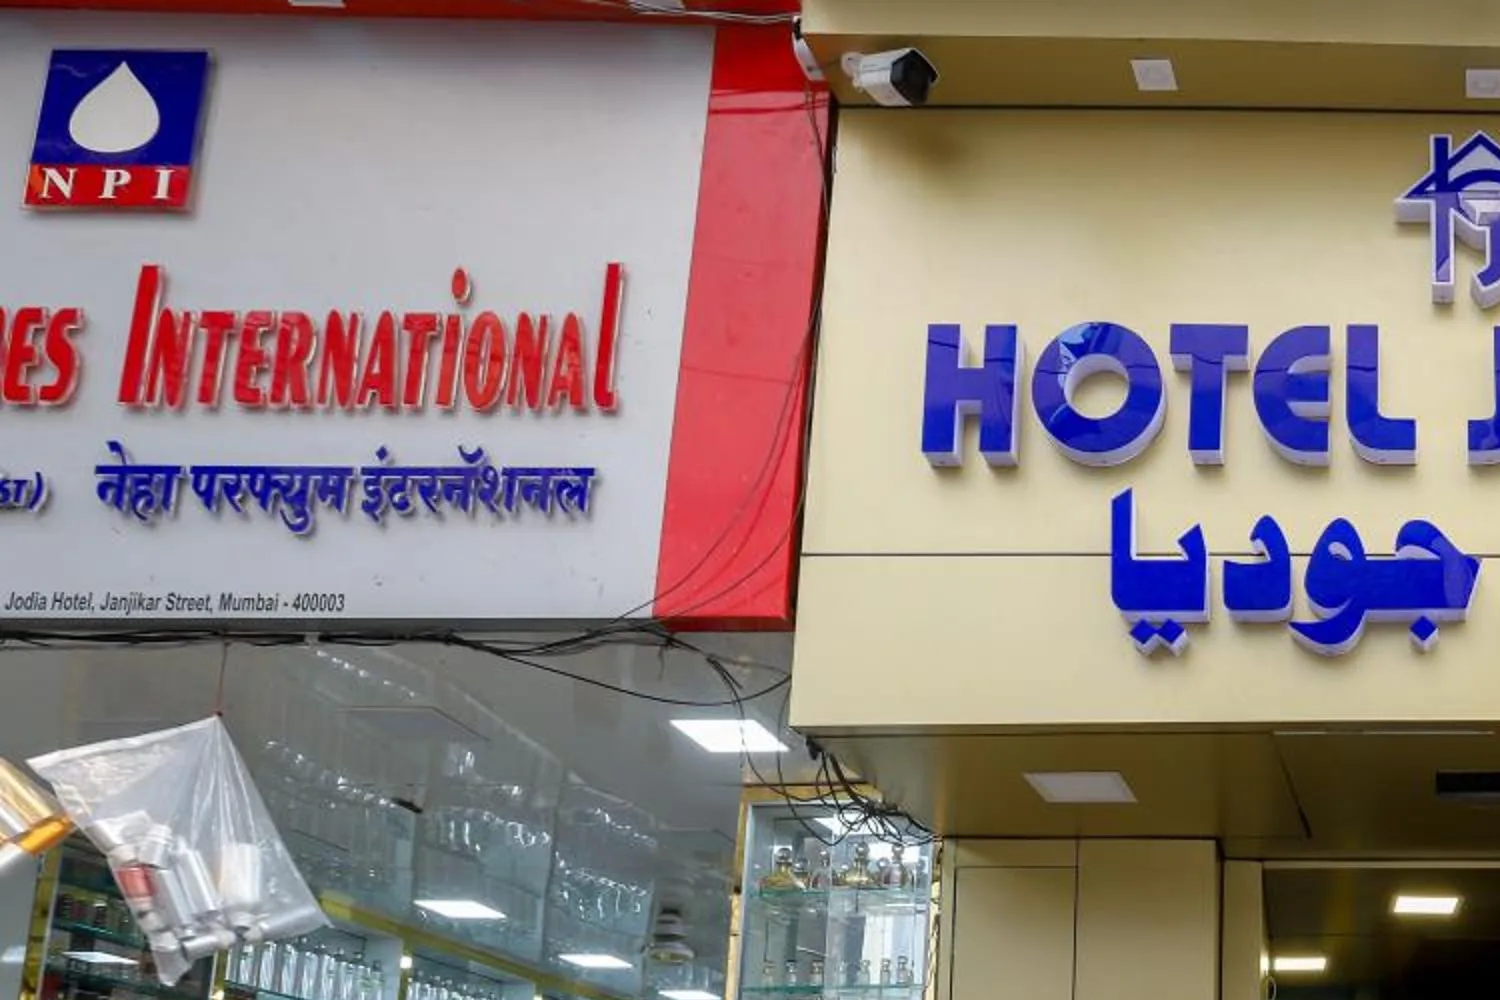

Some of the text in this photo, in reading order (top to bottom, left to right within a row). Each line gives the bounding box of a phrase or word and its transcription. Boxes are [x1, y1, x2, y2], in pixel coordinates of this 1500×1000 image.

[0, 305, 84, 407] ES
[921, 321, 1417, 468] HOTEL
[95, 440, 184, 521] नेहा
[4, 591, 47, 611] Jodia
[51, 591, 95, 613] Hotel,
[100, 591, 162, 616] Janjikar
[165, 591, 213, 614] Street,
[218, 591, 279, 612] Mumbai
[292, 592, 346, 613] 400003
[1111, 487, 1483, 657] جوديا
